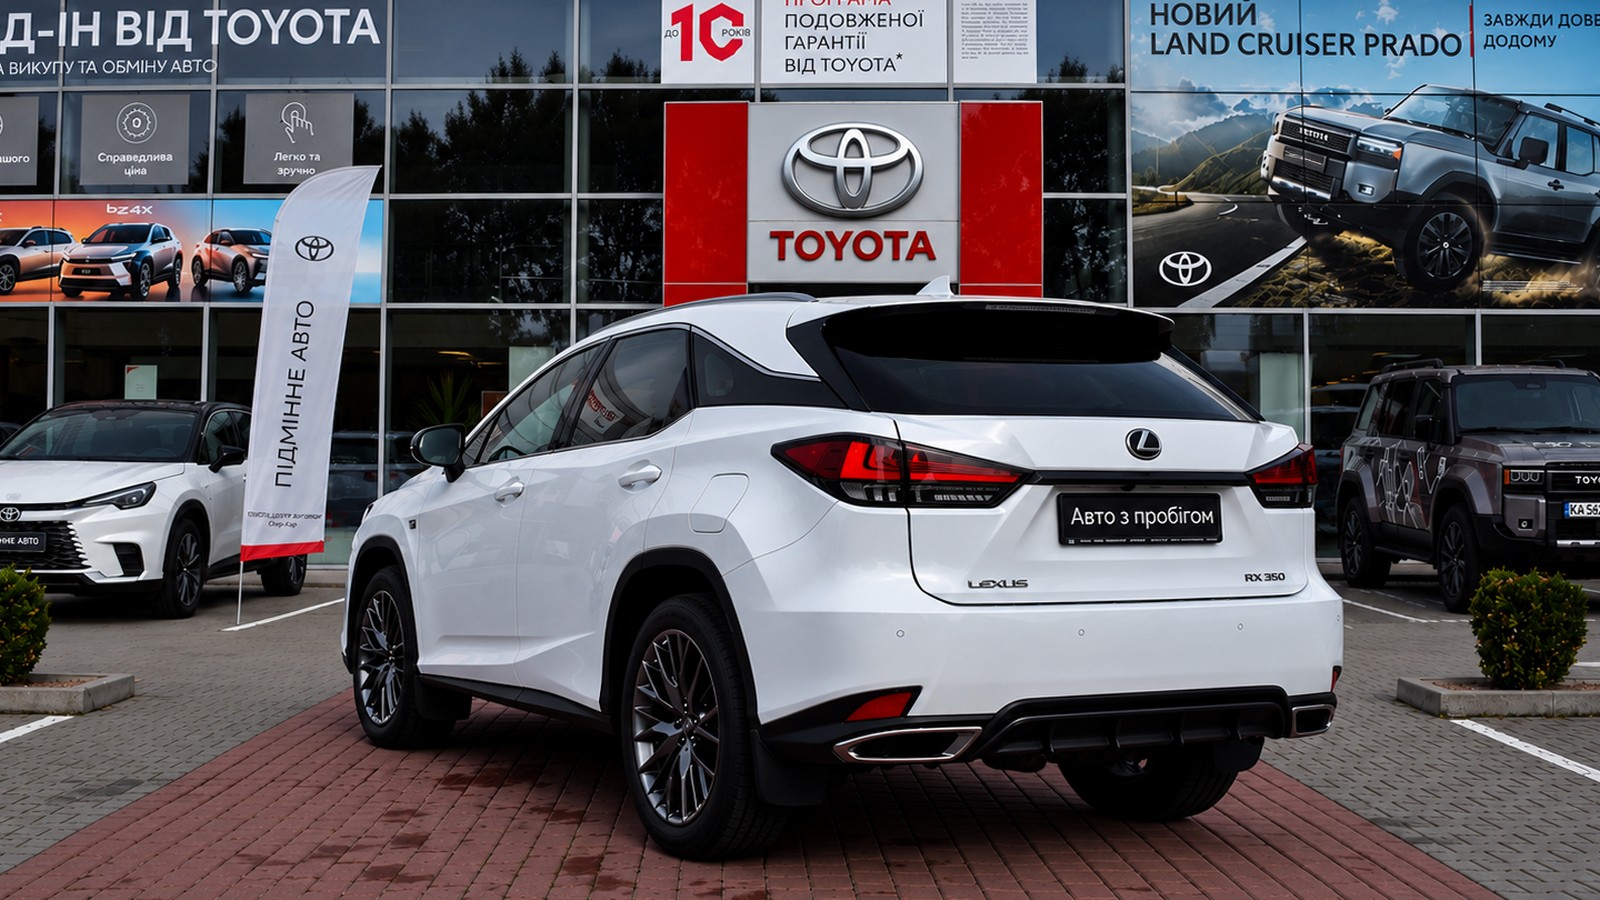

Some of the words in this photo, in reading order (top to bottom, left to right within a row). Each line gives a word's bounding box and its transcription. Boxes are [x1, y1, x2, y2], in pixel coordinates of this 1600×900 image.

[785, 10, 925, 30] ПОДОВЖЕНОЇ
[1151, 0, 1257, 26] НОВИЙ
[1484, 13, 1553, 28] ЗАВЖДИ
[116, 10, 193, 53] ВІД
[203, 8, 381, 46] TOYOTA
[664, 29, 680, 39] ДО
[1151, 32, 1230, 56] LAND
[1237, 32, 1356, 57] CRUISER
[1364, 33, 1463, 57] PRADO
[1484, 34, 1557, 50] ДОДОМУ
[9, 61, 75, 75] ВИКУПУ
[78, 61, 98, 74] ТА
[102, 59, 168, 74] ОБМІНУ
[170, 59, 218, 73] АВТО
[785, 58, 816, 75] ВІД
[98, 152, 173, 165] Справедлива
[274, 152, 306, 161] Легко
[309, 153, 321, 161] та
[124, 165, 147, 177] ціна
[277, 167, 316, 177] зручно
[769, 230, 937, 262] TOYOTA
[274, 368, 306, 488] ПІДМІННЕ
[291, 300, 315, 362] АВТО
[1070, 507, 1116, 526] Авто
[1120, 511, 1130, 525] з
[1134, 506, 1214, 529] пробігом
[967, 579, 1029, 589] LEXUS
[1244, 573, 1262, 582] RX
[1263, 572, 1286, 582] 350
